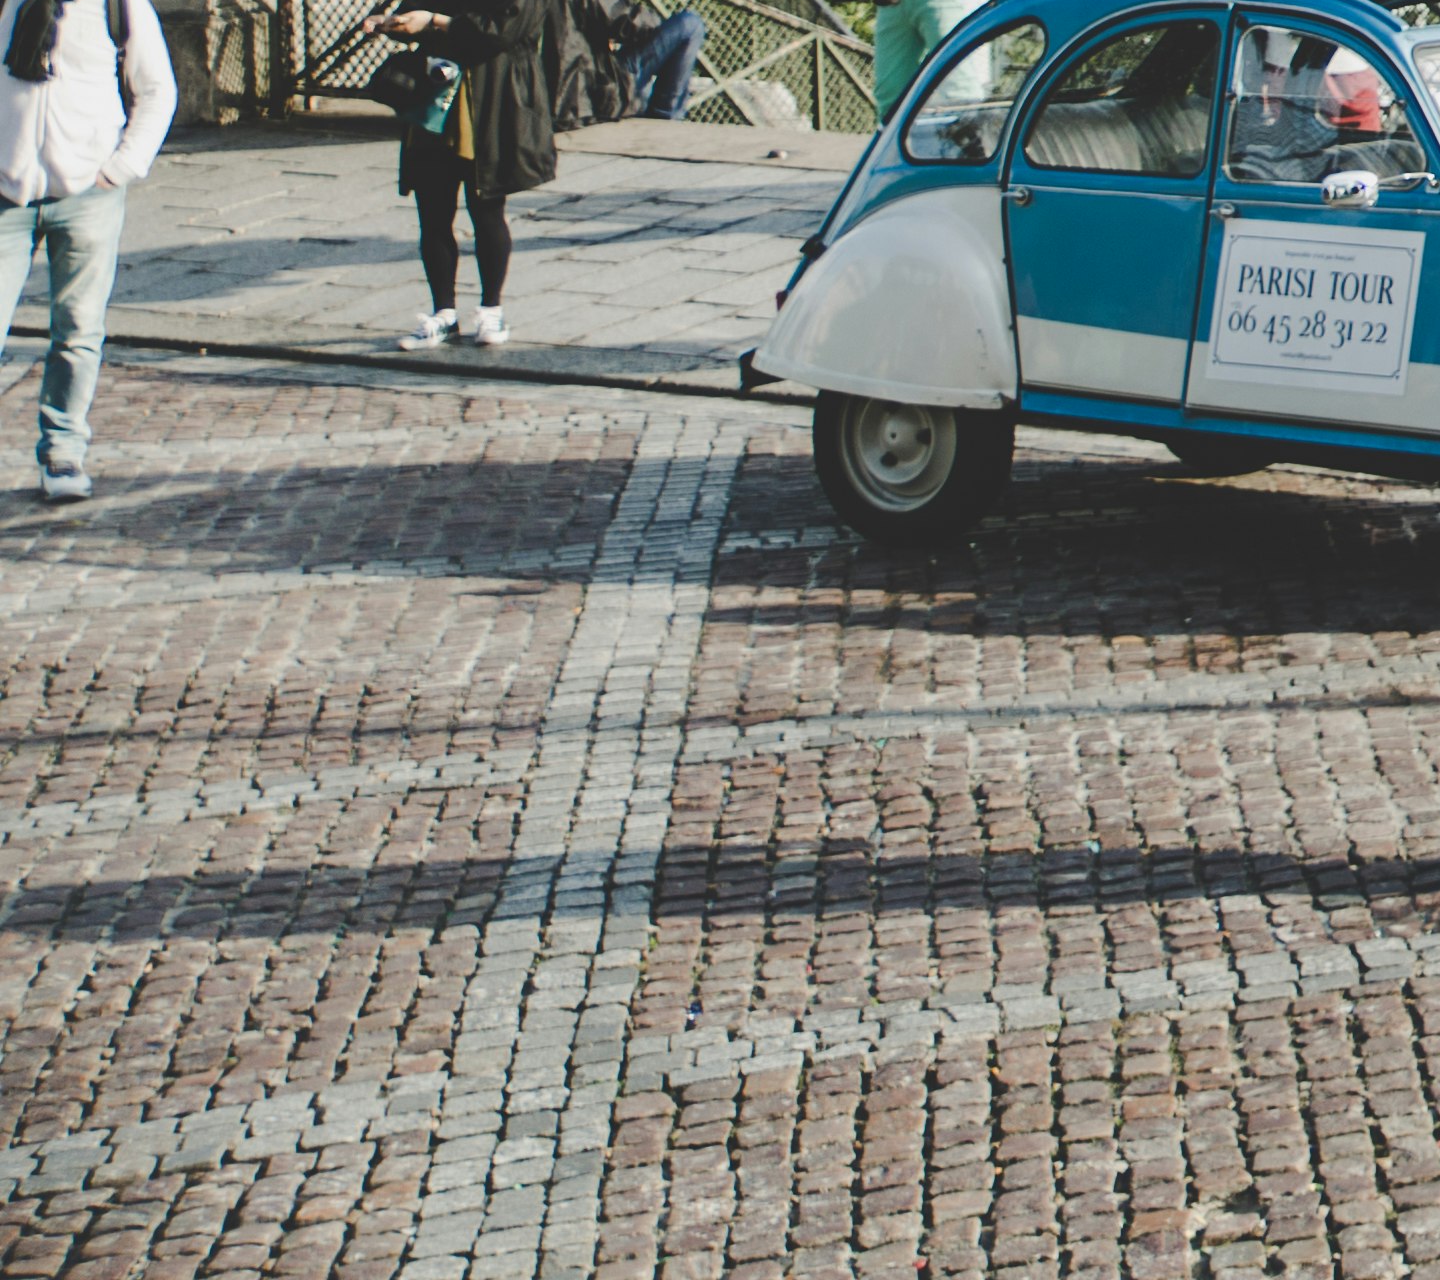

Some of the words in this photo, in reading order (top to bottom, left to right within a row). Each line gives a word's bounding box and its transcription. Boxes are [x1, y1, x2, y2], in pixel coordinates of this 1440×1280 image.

[1237, 264, 1317, 299] PARISI
[1329, 271, 1394, 305] TOUR
[1228, 304, 1258, 333] 06
[1262, 314, 1292, 345] 45
[1298, 310, 1327, 339] 28
[1331, 318, 1354, 349] 31
[1361, 321, 1388, 344] 22
